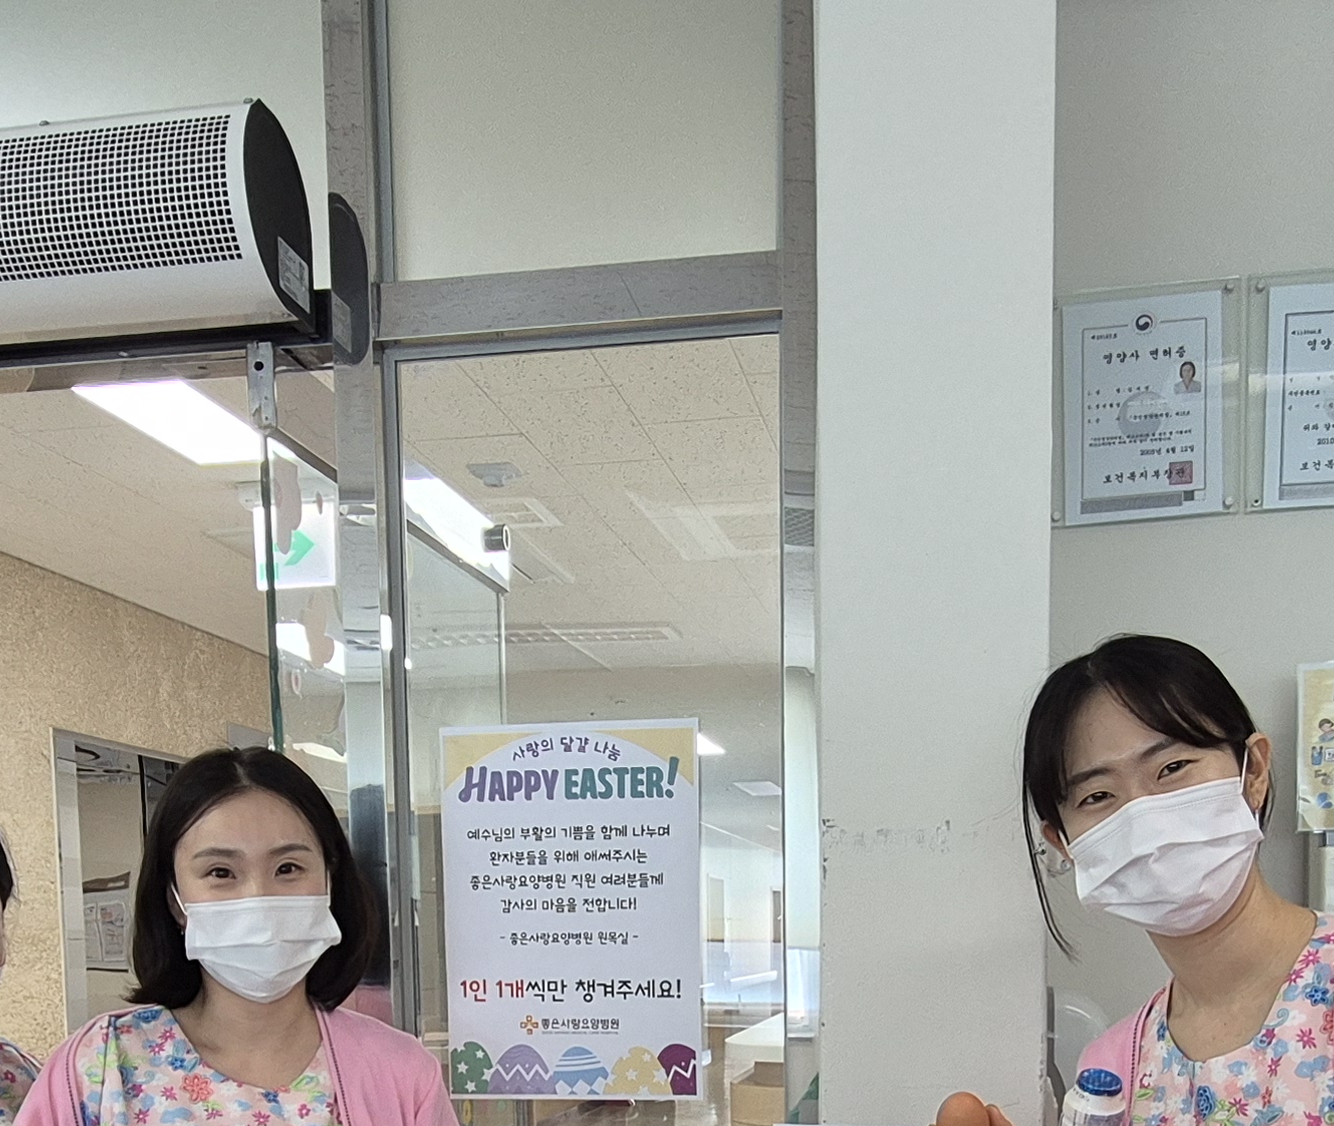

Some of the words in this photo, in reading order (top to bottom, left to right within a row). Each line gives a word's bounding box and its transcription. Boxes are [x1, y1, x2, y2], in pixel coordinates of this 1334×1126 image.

[511, 736, 553, 761] 사랑의
[560, 736, 589, 753] 달걀
[594, 741, 620, 761] 나눔
[457, 765, 559, 802] HAPPY
[565, 756, 680, 800] EASTER!
[467, 827, 514, 841] 예수님의
[520, 827, 556, 840] 부활의
[563, 825, 595, 840] 기쁨을
[601, 825, 627, 838] 함께
[633, 824, 670, 838] 나누며
[490, 850, 548, 866] 환자분들을
[554, 850, 579, 863] 위해
[584, 849, 647, 863] 애써주시는
[470, 874, 566, 890] 좋은사랑요양병원
[571, 874, 595, 888] 직원
[501, 899, 536, 913] 감사의
[542, 898, 577, 913] 마음을
[583, 897, 636, 912] 전합니다!
[510, 932, 592, 945] 좋은사랑요양병원
[598, 931, 628, 945] 원목실
[460, 980, 486, 1000] 1인
[496, 979, 567, 1002] 1개씩만
[576, 979, 681, 1002] 챙겨주세요!
